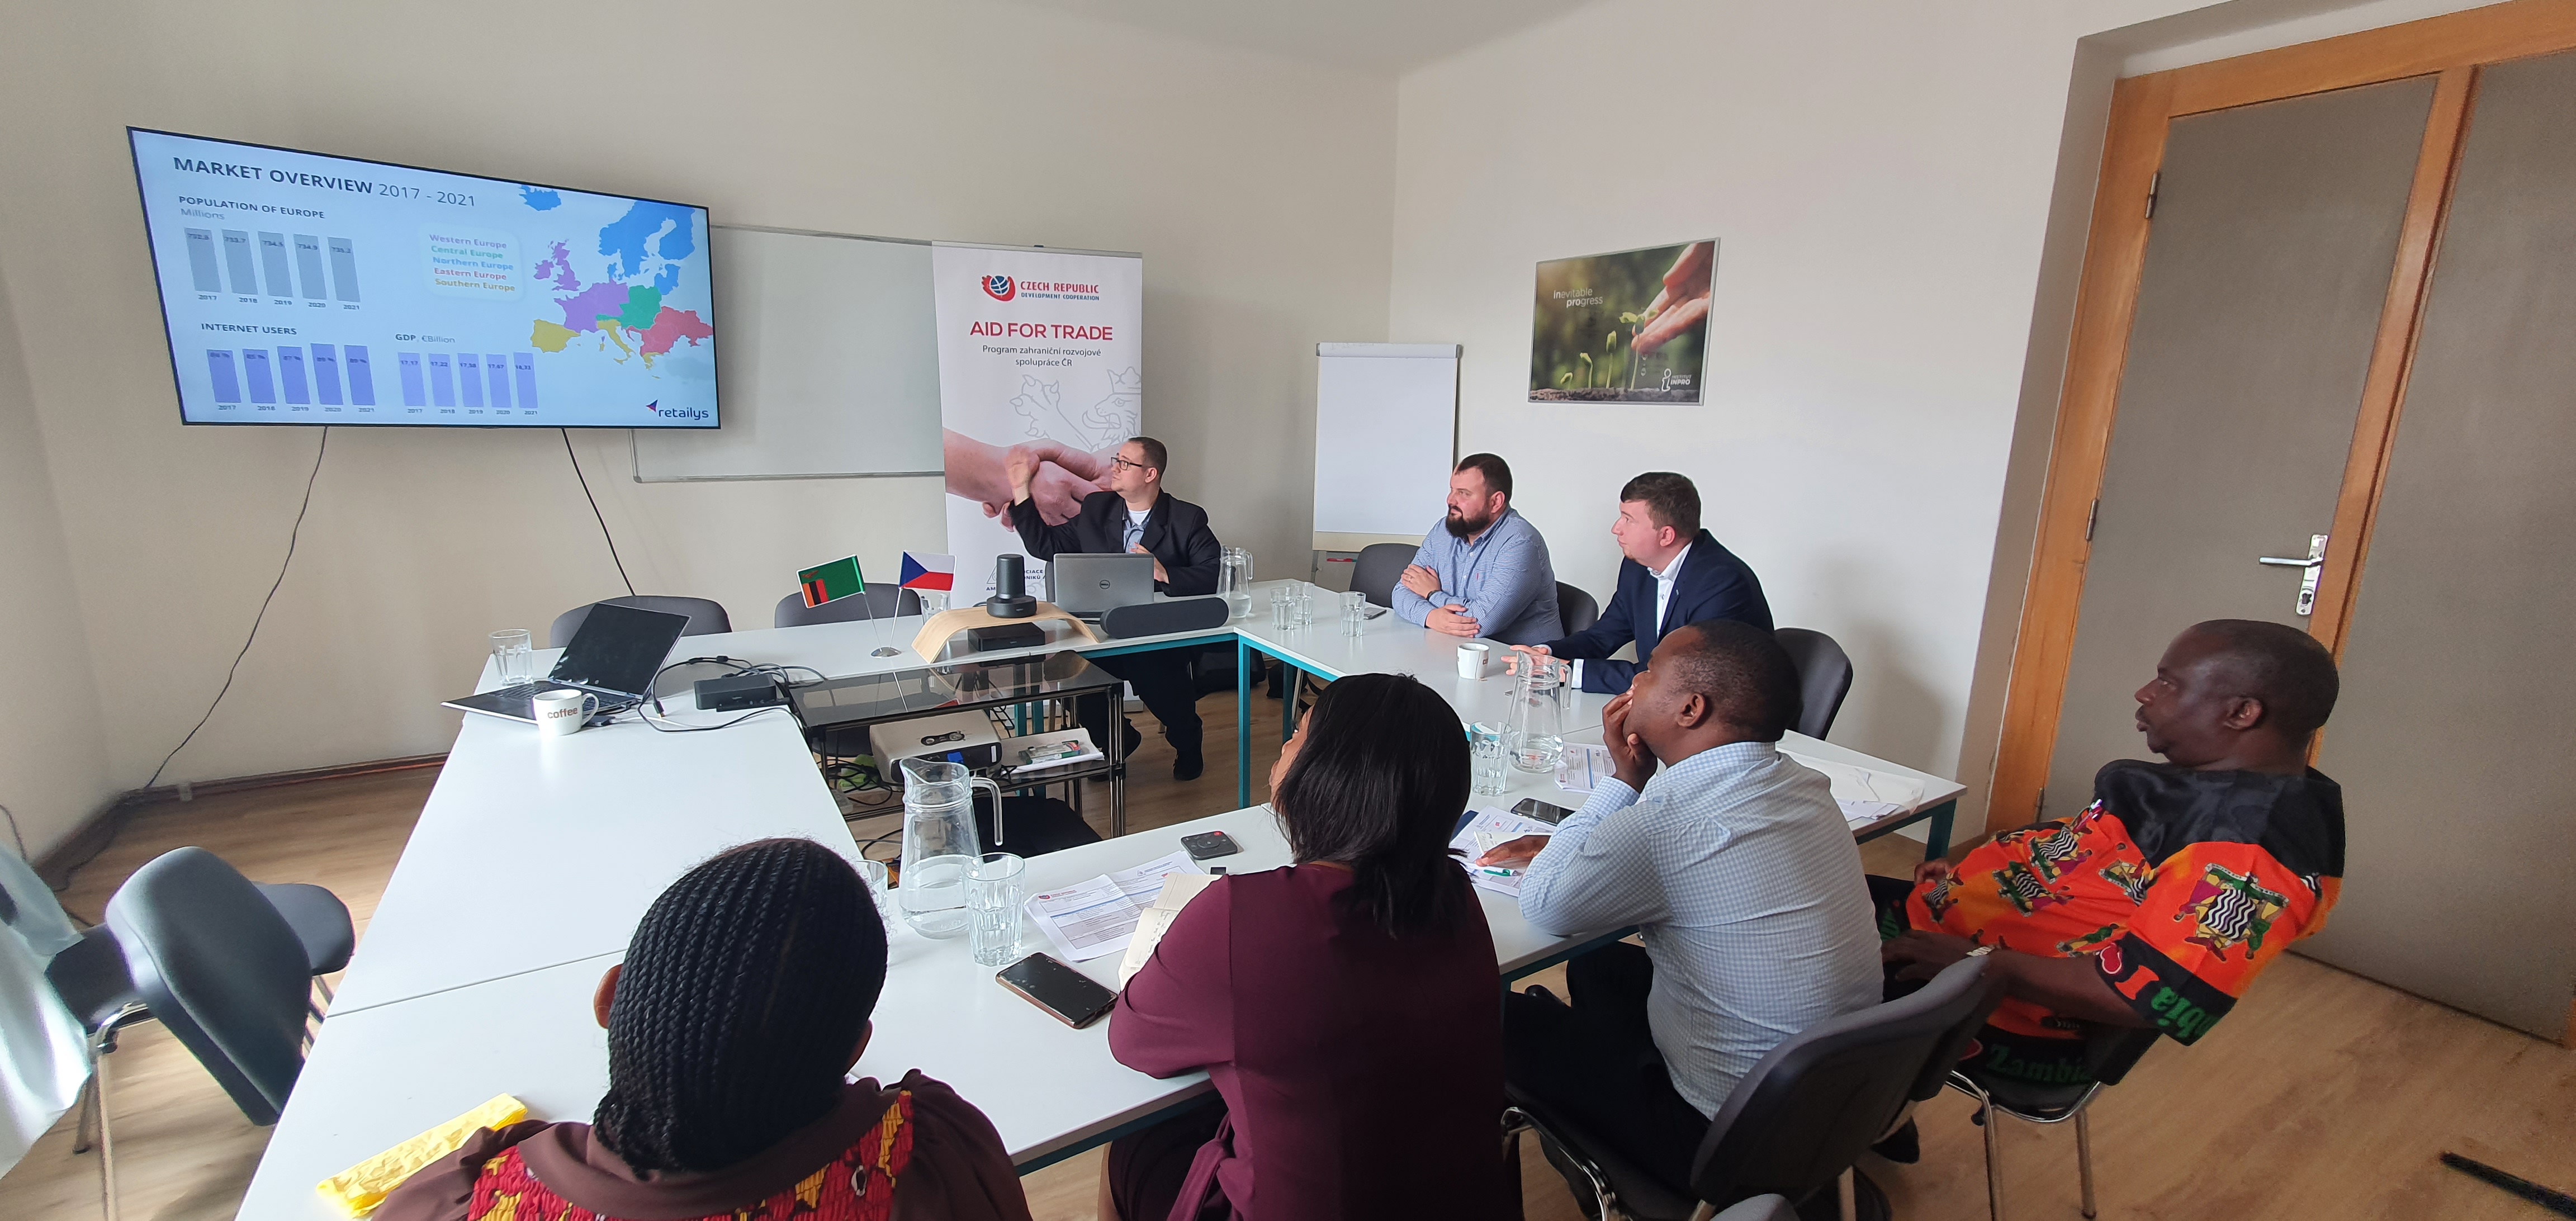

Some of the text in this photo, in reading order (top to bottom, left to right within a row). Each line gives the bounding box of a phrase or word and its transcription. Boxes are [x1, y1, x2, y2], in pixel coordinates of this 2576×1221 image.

[173, 157, 262, 179] MARKET
[269, 169, 372, 194] OVERVIEW
[378, 183, 420, 199] 2017
[437, 191, 475, 206] 2021
[179, 196, 258, 211] POPULATION
[281, 207, 325, 219] EUROPE
[181, 209, 225, 220] Millions
[429, 234, 506, 249] Western Europe
[431, 245, 503, 259] Central Europe
[433, 257, 514, 271] Northern Europe
[434, 267, 506, 281] Eastern Europe
[435, 278, 515, 292] Southern Europe
[1020, 281, 1099, 294] CZECH REPUBLIC
[1554, 287, 1593, 299] Inevitable
[1566, 296, 1603, 308] progress
[201, 323, 297, 335] INTERNET USERS
[970, 321, 1113, 340] AID FOR TRADE
[983, 345, 1101, 357] Program zahraniční rozvojové
[1015, 358, 1072, 367] spolupráce ČR
[659, 407, 709, 420] retailys
[547, 707, 578, 719] coffee
